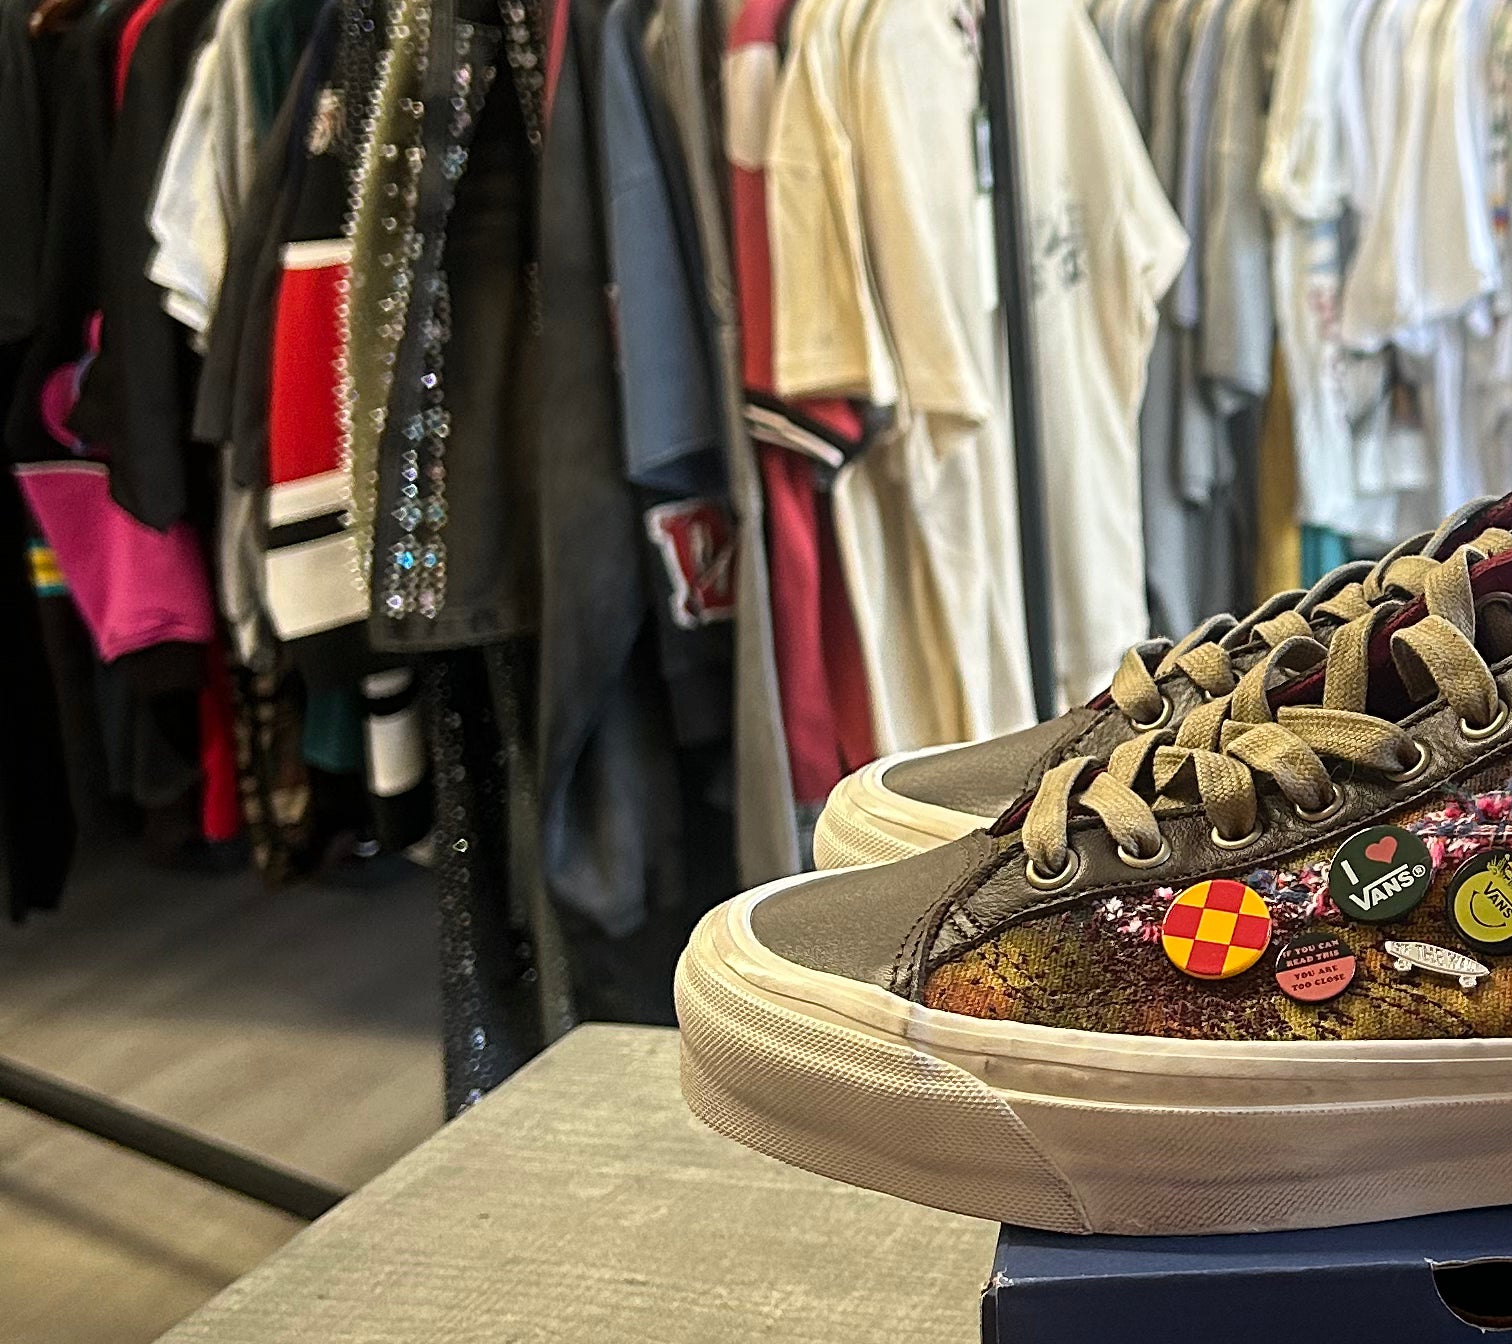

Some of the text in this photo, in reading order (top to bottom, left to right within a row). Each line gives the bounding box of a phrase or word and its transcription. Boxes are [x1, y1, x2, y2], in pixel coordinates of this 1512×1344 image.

[1340, 859, 1359, 886] I
[1282, 939, 1339, 958] IF YOU CAN
[1286, 949, 1340, 967] READ THIS
[1294, 965, 1338, 980] YOU ARE
[1292, 973, 1346, 991] TOO CLOSE
